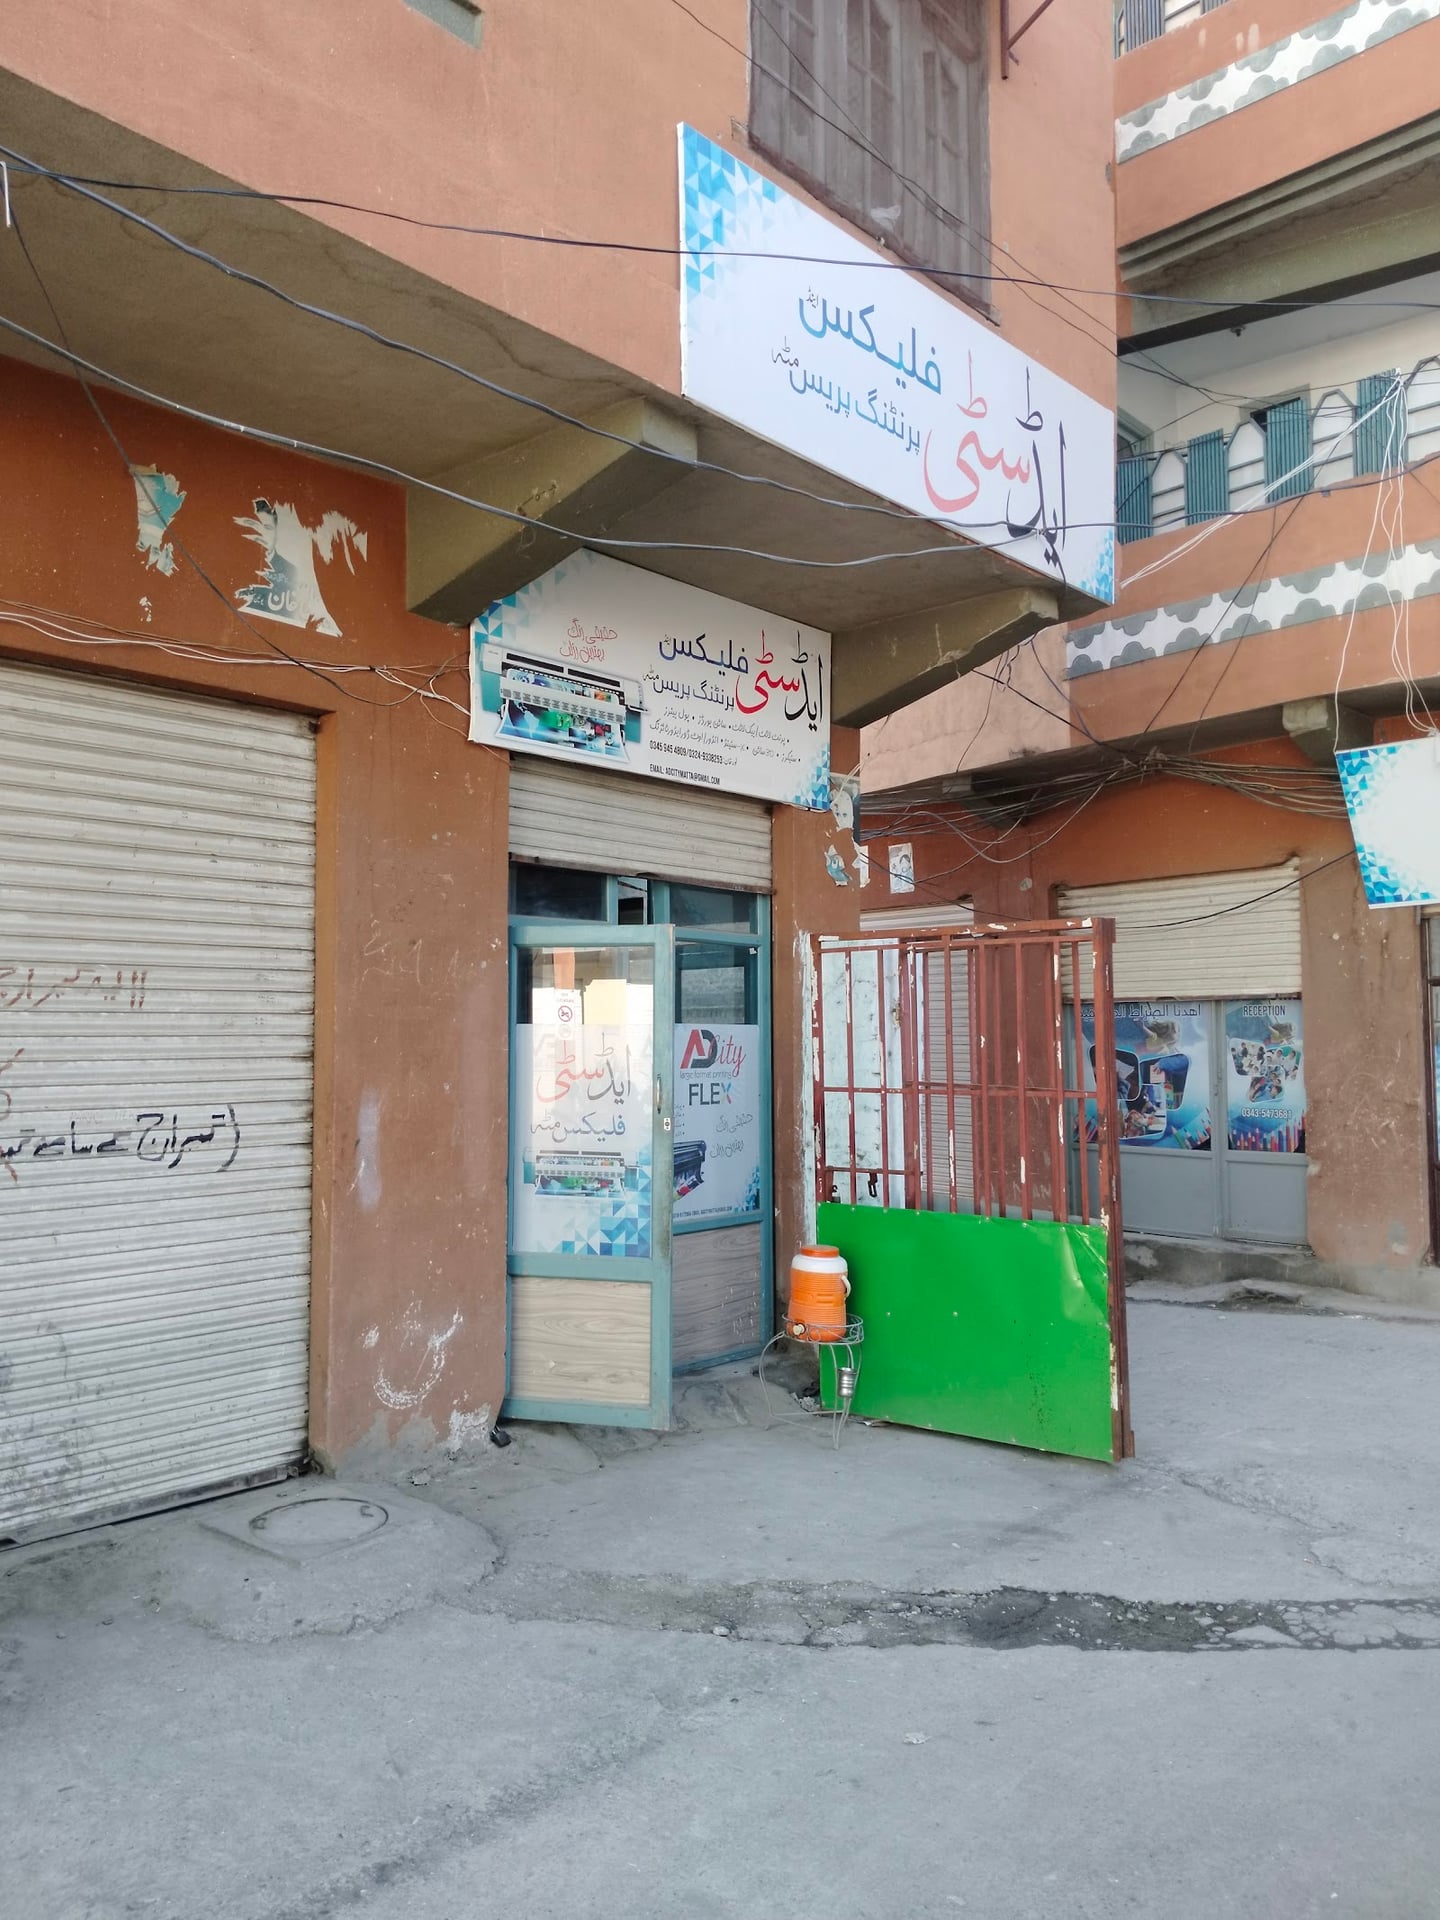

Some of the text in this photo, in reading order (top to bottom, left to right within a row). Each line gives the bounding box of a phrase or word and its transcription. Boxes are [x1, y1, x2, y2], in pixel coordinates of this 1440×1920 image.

[798, 297, 942, 395] فلیکس
[788, 365, 852, 418] پریس
[855, 388, 921, 455] پرنٹنگ
[585, 625, 619, 645] حقیقی
[658, 633, 749, 677] فلیکس
[652, 676, 692, 701] پریس
[692, 680, 736, 712] پرنٹنگ
[649, 763, 665, 775] EMAIL:
[1243, 1004, 1286, 1017] RECEPTION
[688, 1082, 733, 1106] FLEX
[552, 1111, 627, 1144] فلیکس
